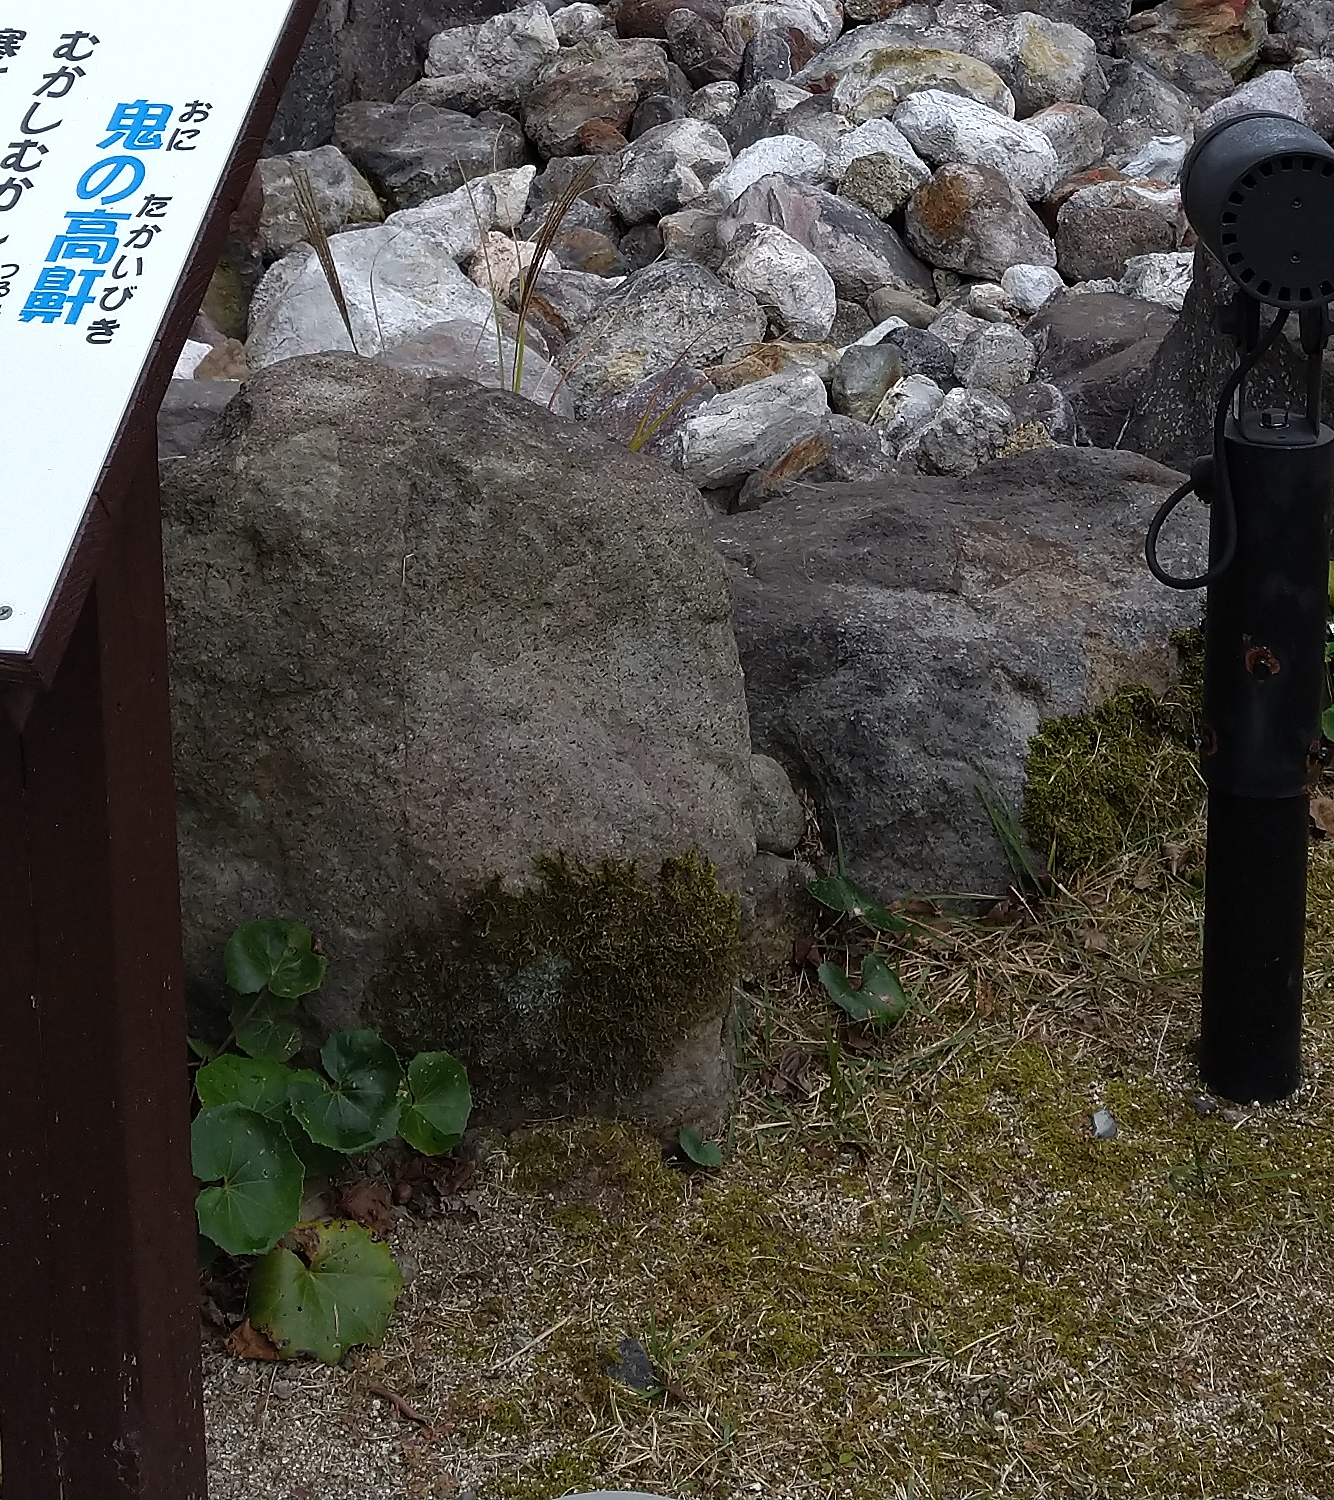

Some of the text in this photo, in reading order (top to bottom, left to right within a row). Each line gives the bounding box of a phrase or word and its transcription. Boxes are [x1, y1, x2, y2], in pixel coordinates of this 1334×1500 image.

[166, 100, 213, 151] おに
[18, 100, 174, 325] 鬼の高鼾
[85, 193, 173, 345] たかいびき
